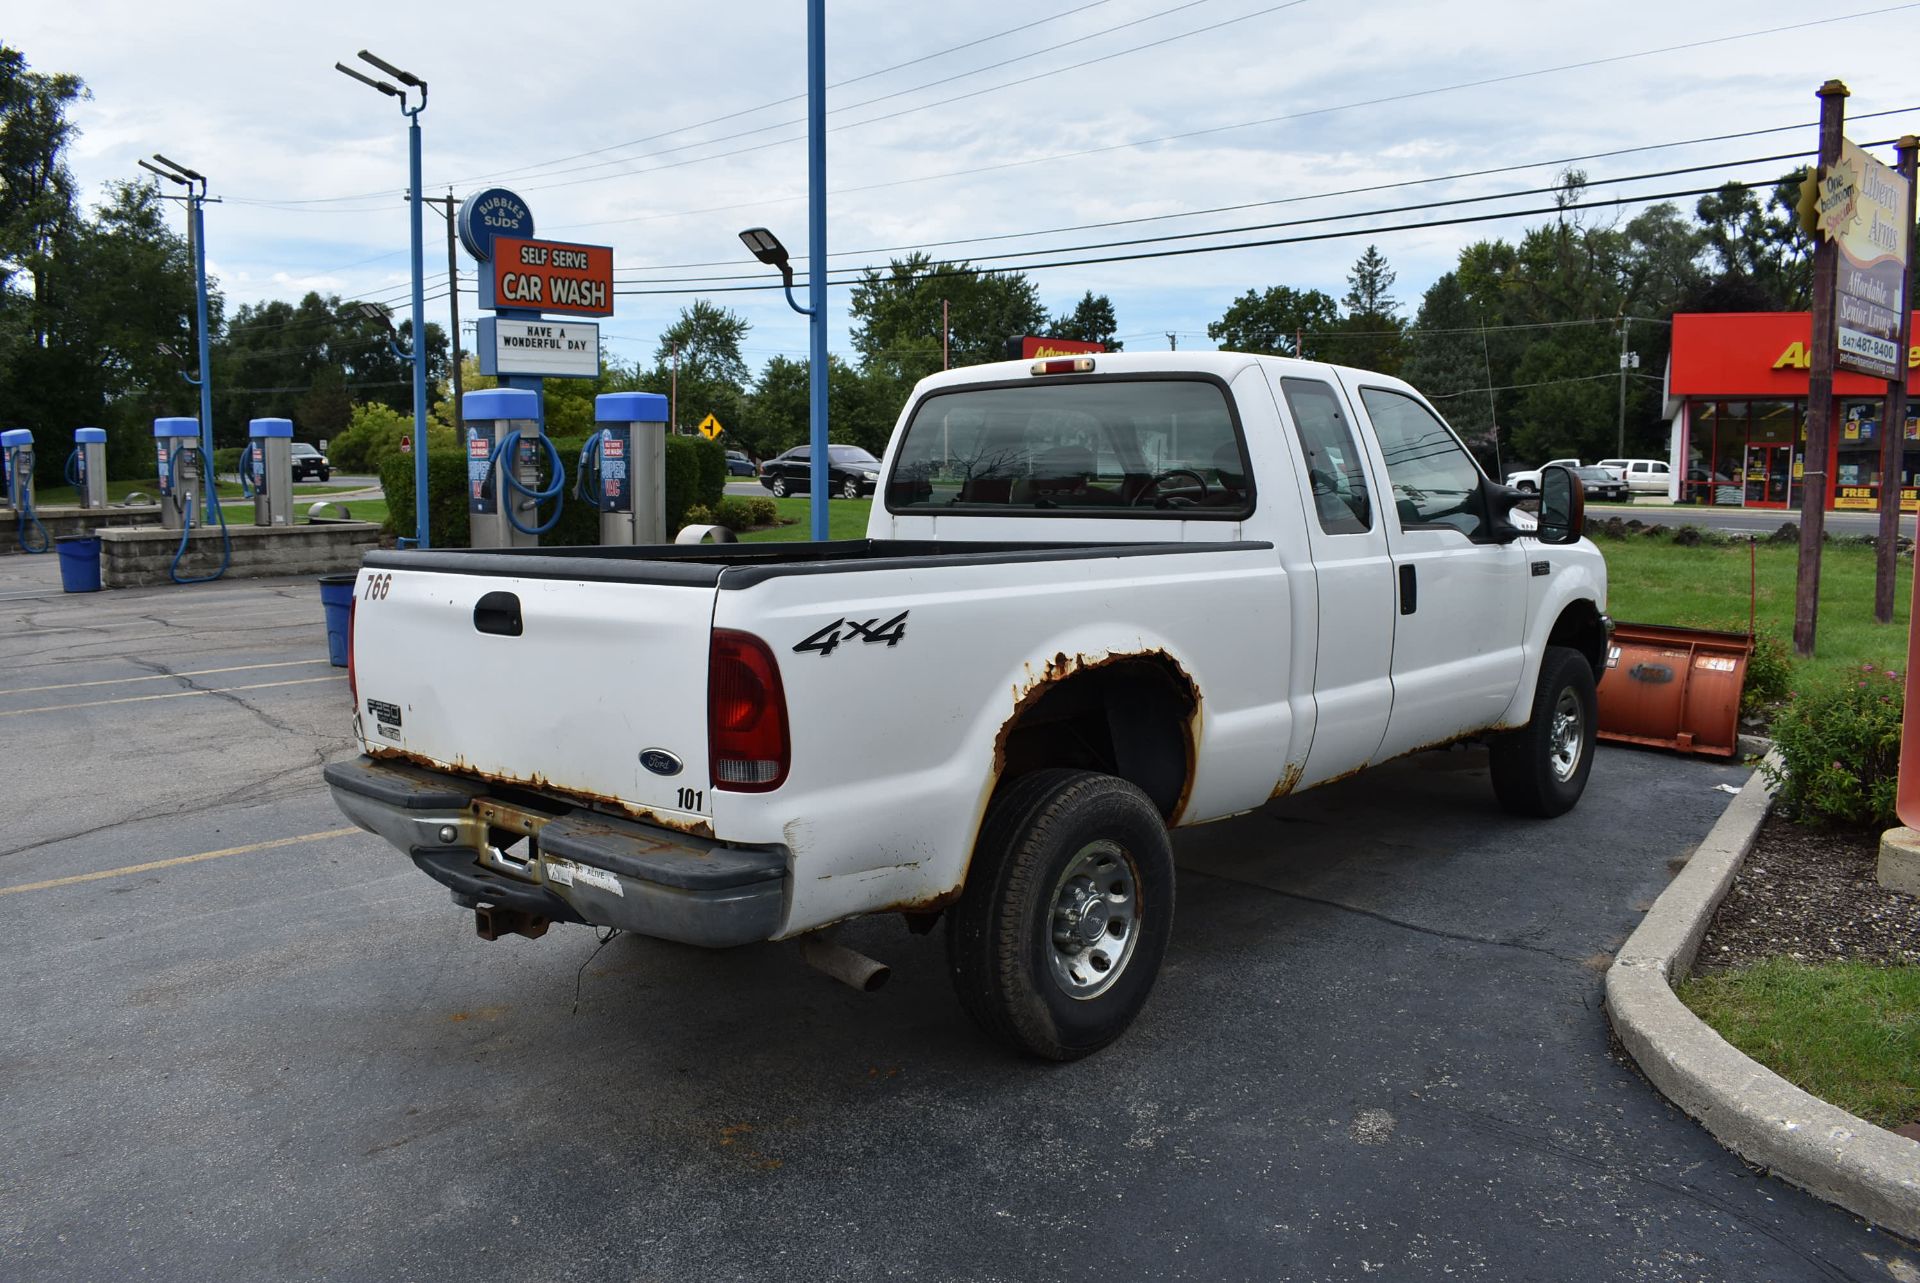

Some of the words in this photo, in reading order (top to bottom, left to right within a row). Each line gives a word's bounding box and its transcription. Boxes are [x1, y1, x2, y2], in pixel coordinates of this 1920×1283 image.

[1827, 174, 1844, 193] One
[1862, 162, 1899, 221] Liberty
[479, 197, 525, 219] BUBBLES
[1820, 184, 1855, 213] bedroom
[484, 215, 519, 229] SUDS
[498, 208, 505, 217] &
[1869, 209, 1897, 252] Arms
[521, 246, 548, 265] SELF
[552, 250, 588, 269] SERVE
[502, 273, 542, 302] CAR
[549, 277, 605, 308] WASH
[1847, 271, 1887, 305] Affordable
[1840, 295, 1867, 326] Senior
[1867, 305, 1892, 340] Living
[503, 335, 562, 350] WONDERFUL
[568, 340, 587, 351] DAY
[527, 326, 552, 337] HAVE
[559, 328, 566, 339] A
[1842, 488, 1871, 498] FREE
[364, 573, 393, 600] 766
[648, 753, 671, 770] Ford
[676, 787, 703, 812] 101
